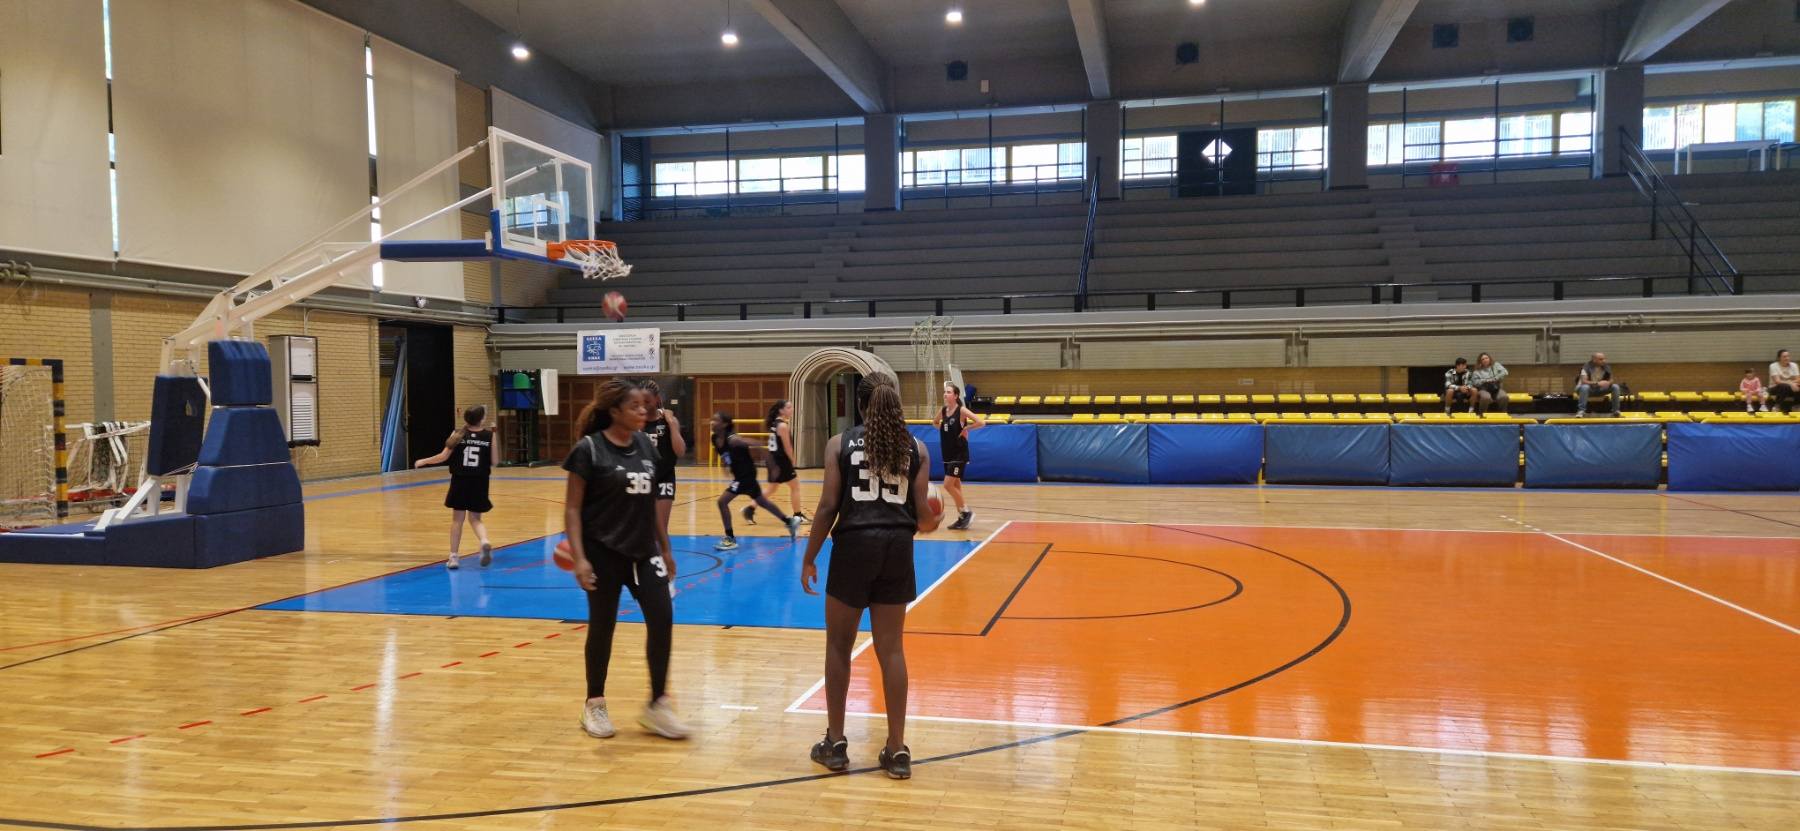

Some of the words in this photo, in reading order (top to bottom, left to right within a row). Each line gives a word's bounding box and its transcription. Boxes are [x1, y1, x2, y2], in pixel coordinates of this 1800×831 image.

[463, 446, 480, 467] 15
[626, 472, 652, 494] 36
[658, 482, 674, 496] 75
